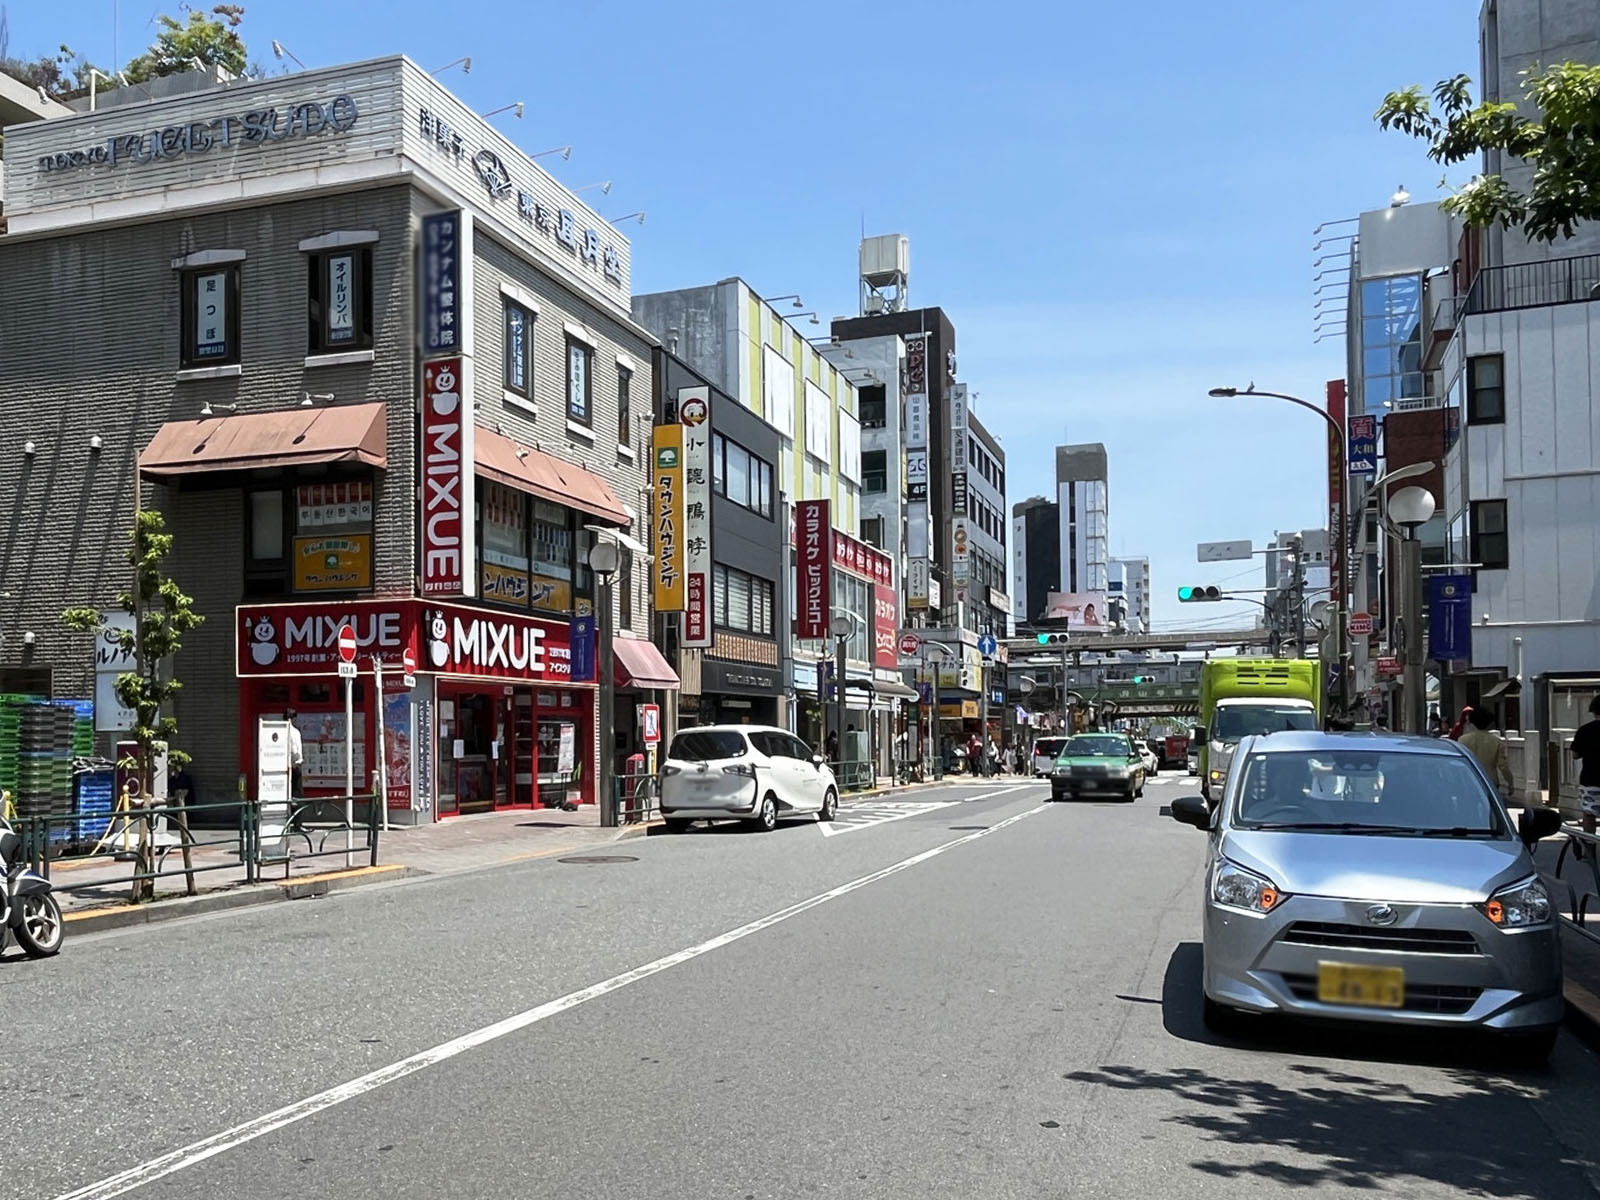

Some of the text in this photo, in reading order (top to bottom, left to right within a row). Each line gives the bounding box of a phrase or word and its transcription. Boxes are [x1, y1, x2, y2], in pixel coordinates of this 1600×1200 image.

[206, 280, 217, 341] 足つぼ
[336, 262, 348, 325] オイルリンパ
[440, 222, 454, 346] カンナム整体院
[1351, 418, 1375, 440] 質
[1352, 444, 1374, 454] 大和
[428, 423, 461, 578] MIXUE
[913, 485, 927, 494] 4F
[660, 476, 679, 589] タウンハウジング
[806, 505, 820, 561] カラオケ
[689, 577, 701, 634] 24時間営業
[808, 564, 822, 636] ビッグエコー
[285, 613, 402, 649] MIXUE
[454, 617, 546, 671] MIXUE
